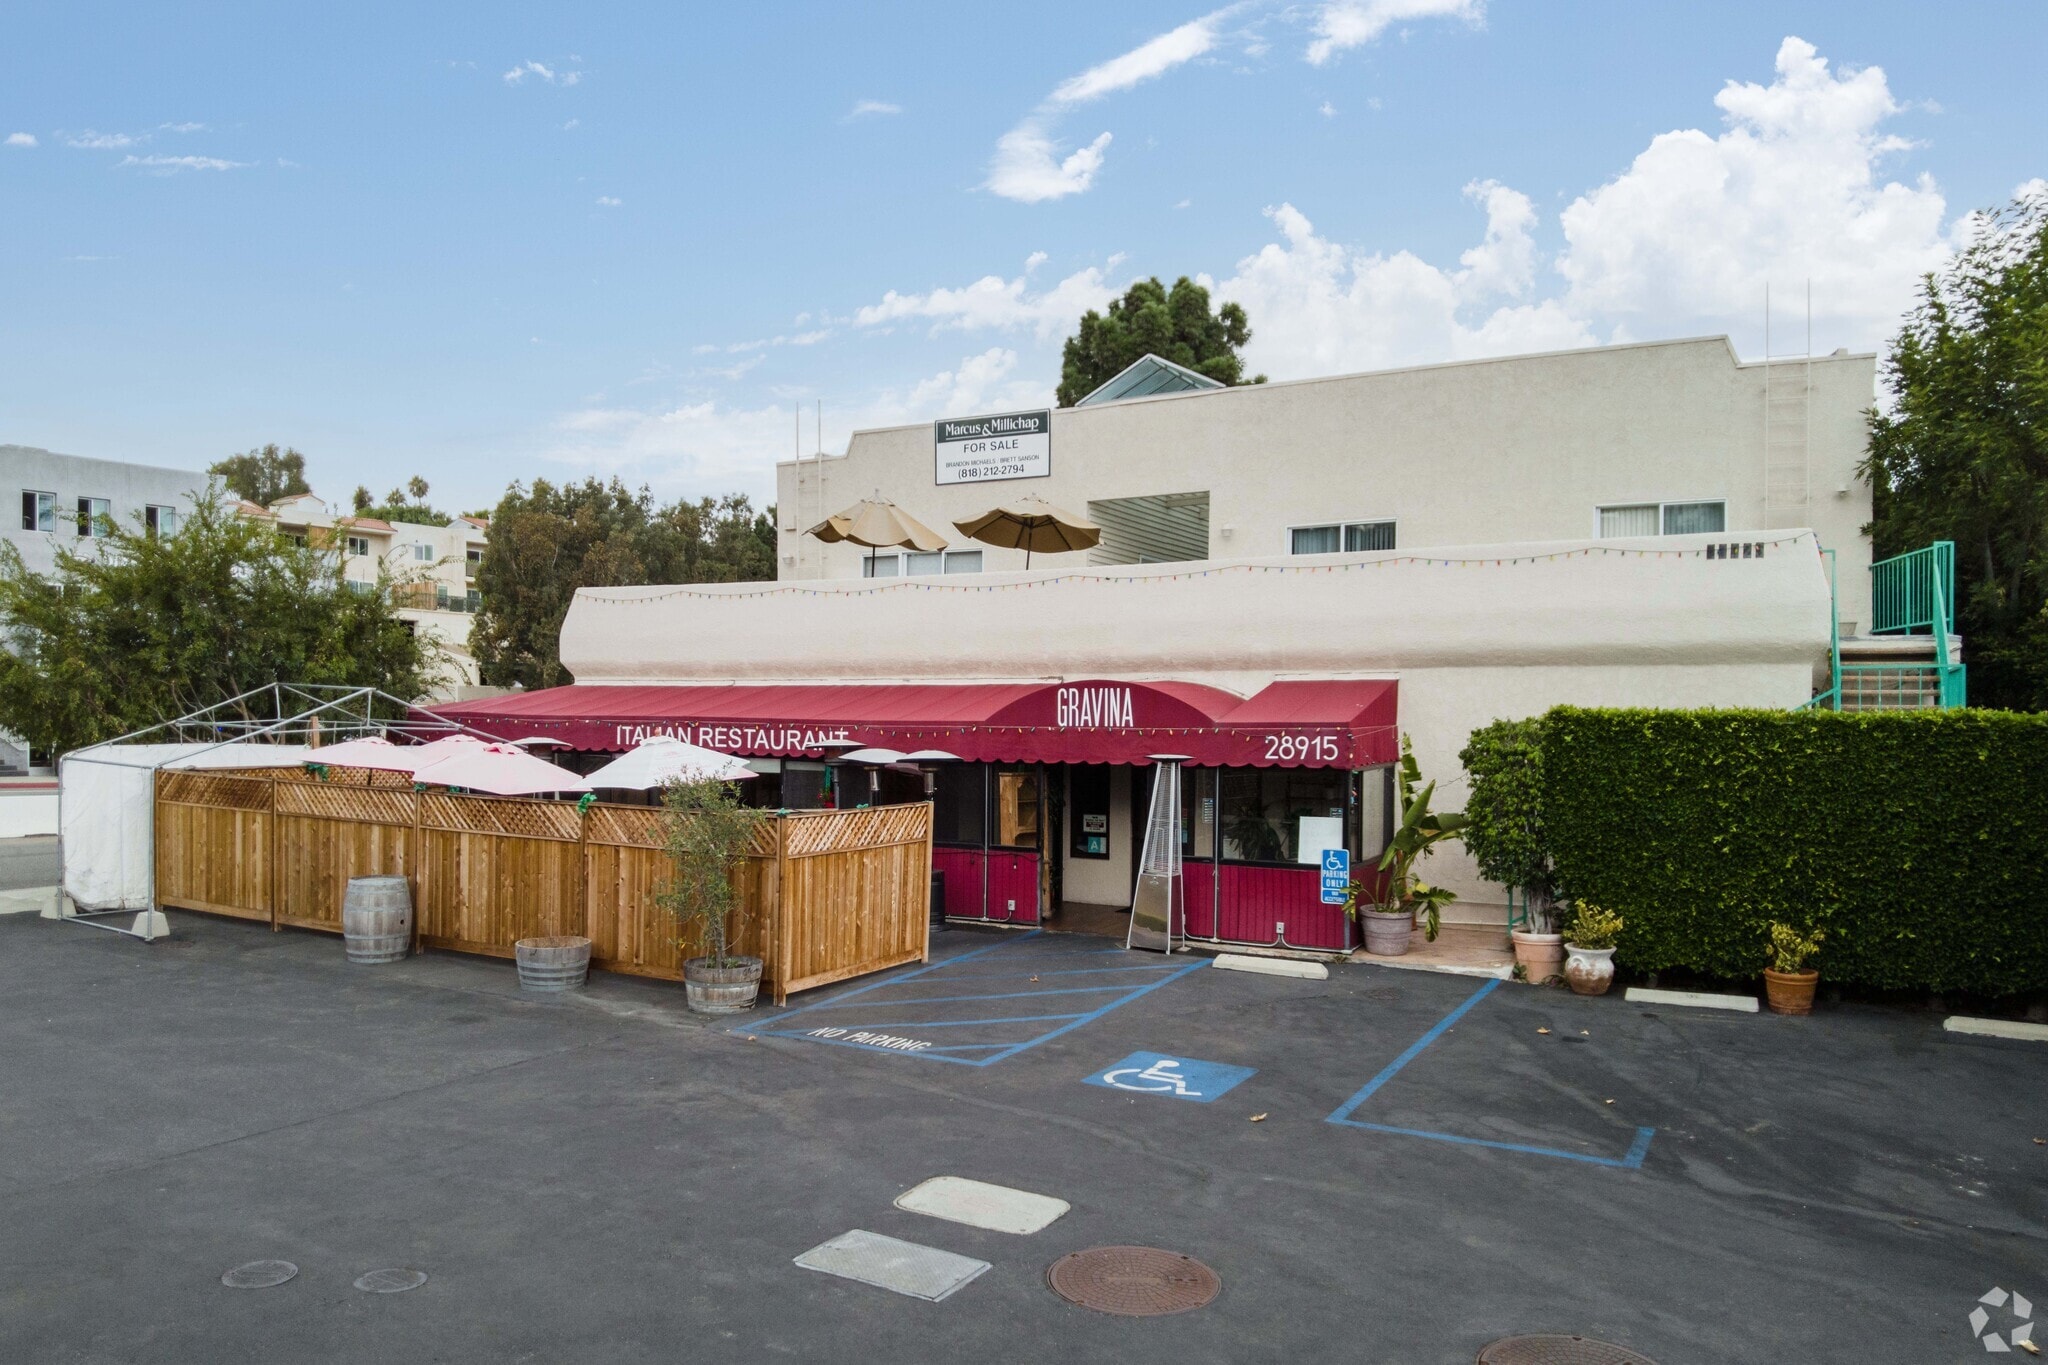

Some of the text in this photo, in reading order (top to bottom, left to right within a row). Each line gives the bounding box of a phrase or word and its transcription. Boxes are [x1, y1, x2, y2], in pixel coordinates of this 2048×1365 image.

[946, 424, 980, 436] Marcus
[992, 416, 1040, 432] Millichap
[964, 440, 1018, 454] FOR SALE
[958, 464, 1024, 480] (818) 212-2794
[1058, 688, 1134, 726] GRAVINA
[1264, 736, 1338, 760] 28915
[1090, 840, 1098, 850] A
[1322, 870, 1348, 878] PARKING
[1326, 880, 1344, 888] ONLY
[806, 1026, 932, 1050] NO PARKING
